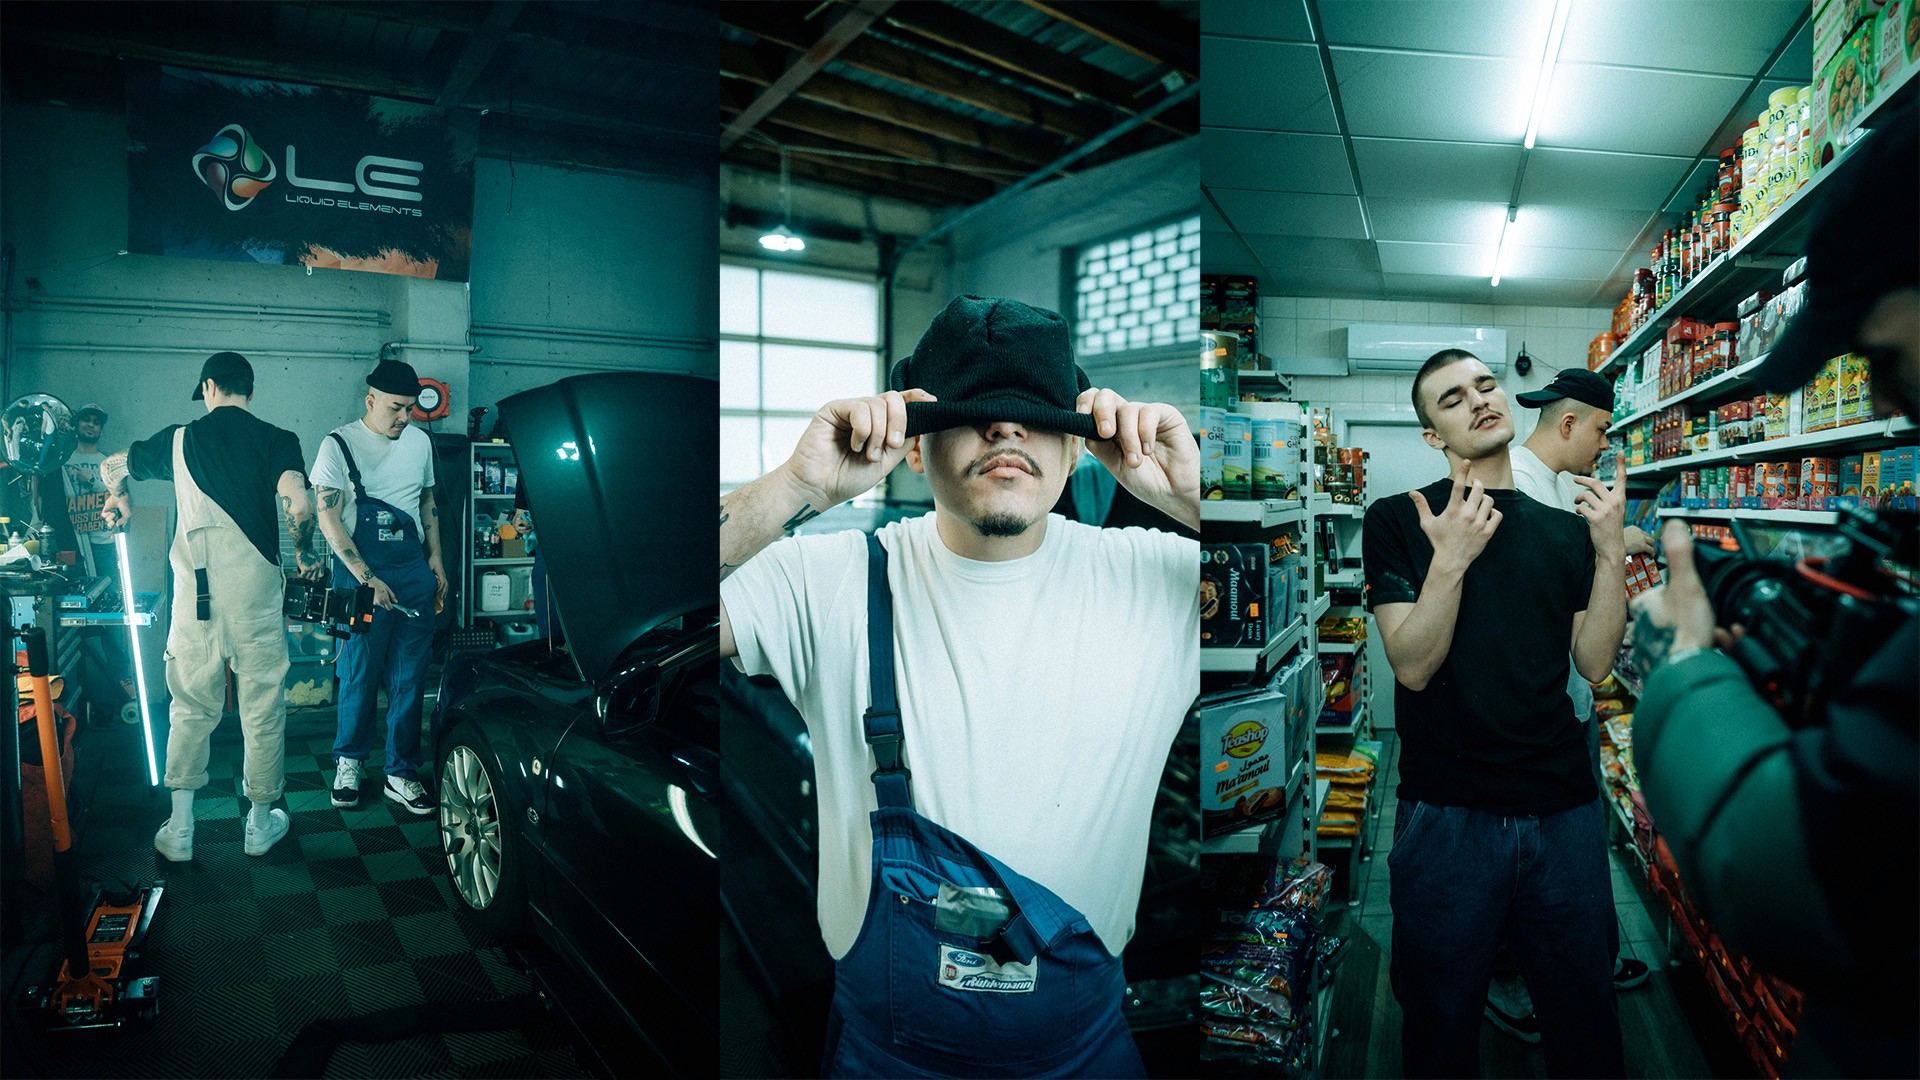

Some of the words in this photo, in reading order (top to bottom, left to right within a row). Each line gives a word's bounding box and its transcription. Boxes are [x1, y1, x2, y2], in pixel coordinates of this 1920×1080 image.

[1769, 109, 1785, 125] DO
[285, 145, 424, 202] LE
[1768, 172, 1784, 187] DO
[285, 194, 335, 208] LIQUID
[337, 199, 423, 218] ELEMENTS
[1207, 431, 1225, 442] GHE
[67, 491, 111, 513] AMME
[70, 512, 89, 525] USS
[76, 520, 104, 534] HABEN
[1230, 567, 1241, 620] Maamoul
[1222, 727, 1269, 755] Teashop
[1215, 760, 1270, 795] Ma'amoul
[955, 952, 978, 966] Ford
